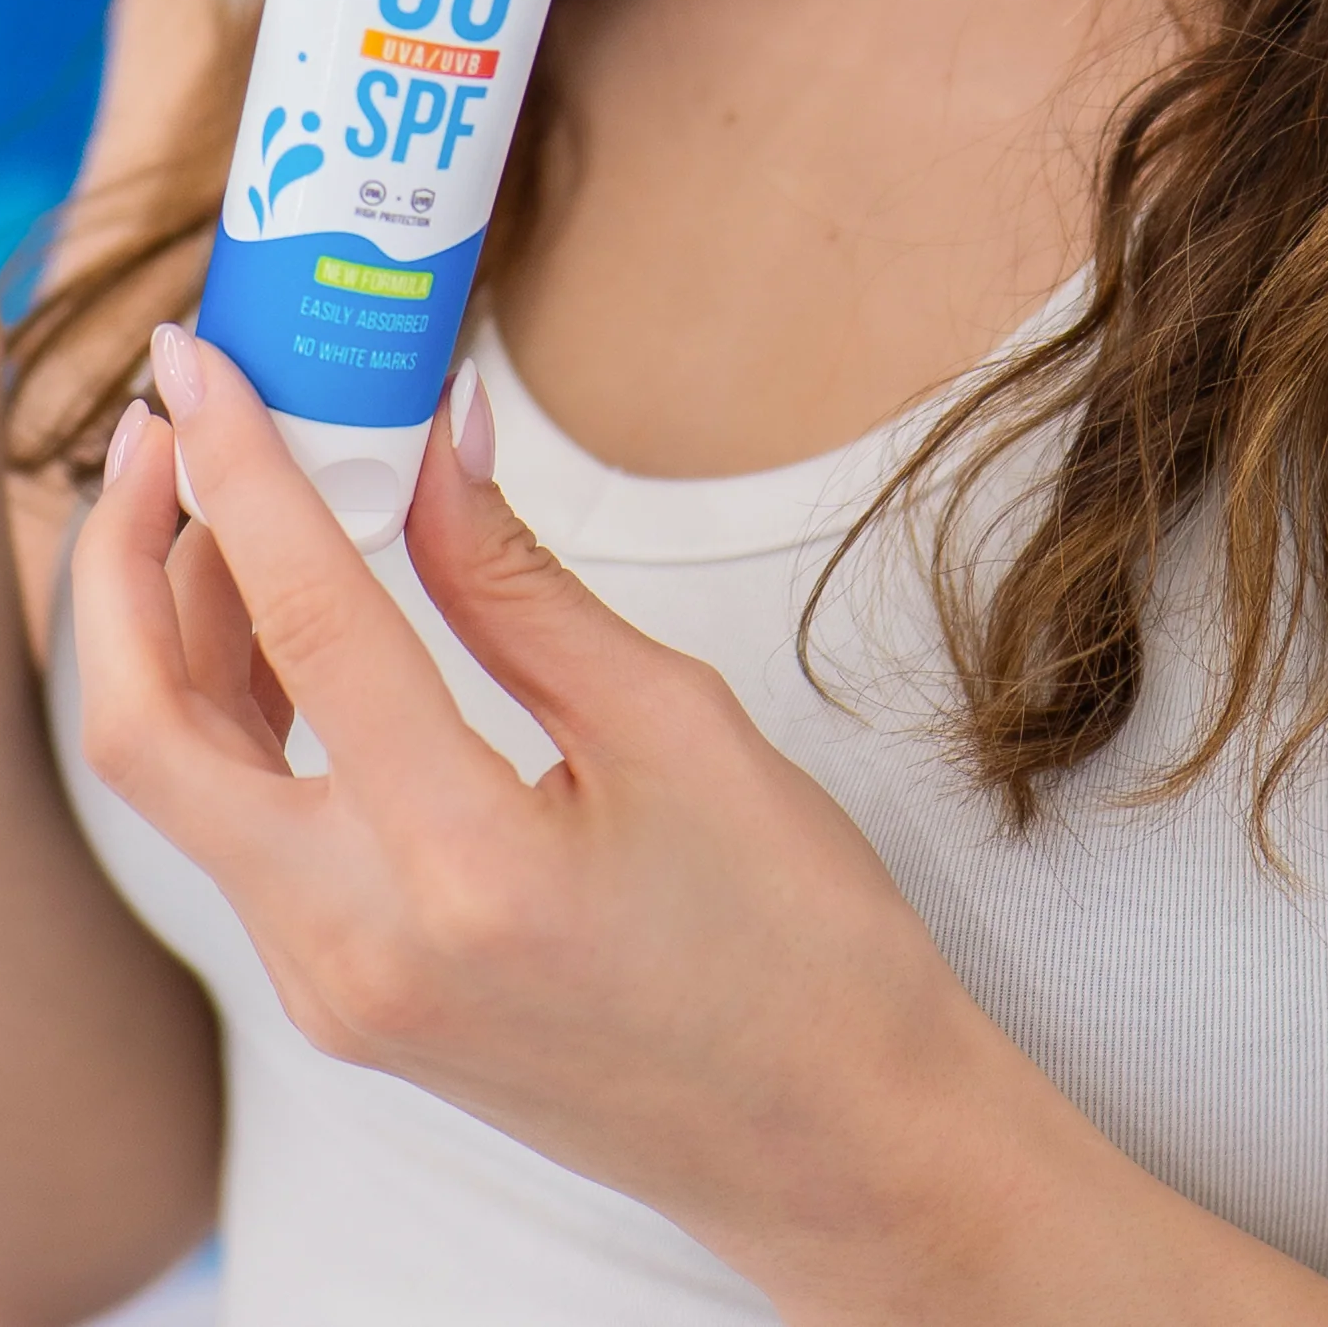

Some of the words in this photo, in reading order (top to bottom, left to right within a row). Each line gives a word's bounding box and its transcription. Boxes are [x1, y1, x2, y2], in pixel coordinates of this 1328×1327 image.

[382, 38, 481, 75] UVA/UVB
[345, 69, 488, 171] SPF
[323, 262, 359, 286] NEW
[361, 270, 428, 295] FORMULA
[300, 296, 354, 326] EASILY
[355, 309, 429, 334] ABSORBED
[293, 334, 316, 357] NO
[319, 341, 367, 368] WHITE
[370, 350, 418, 371] MARKS
